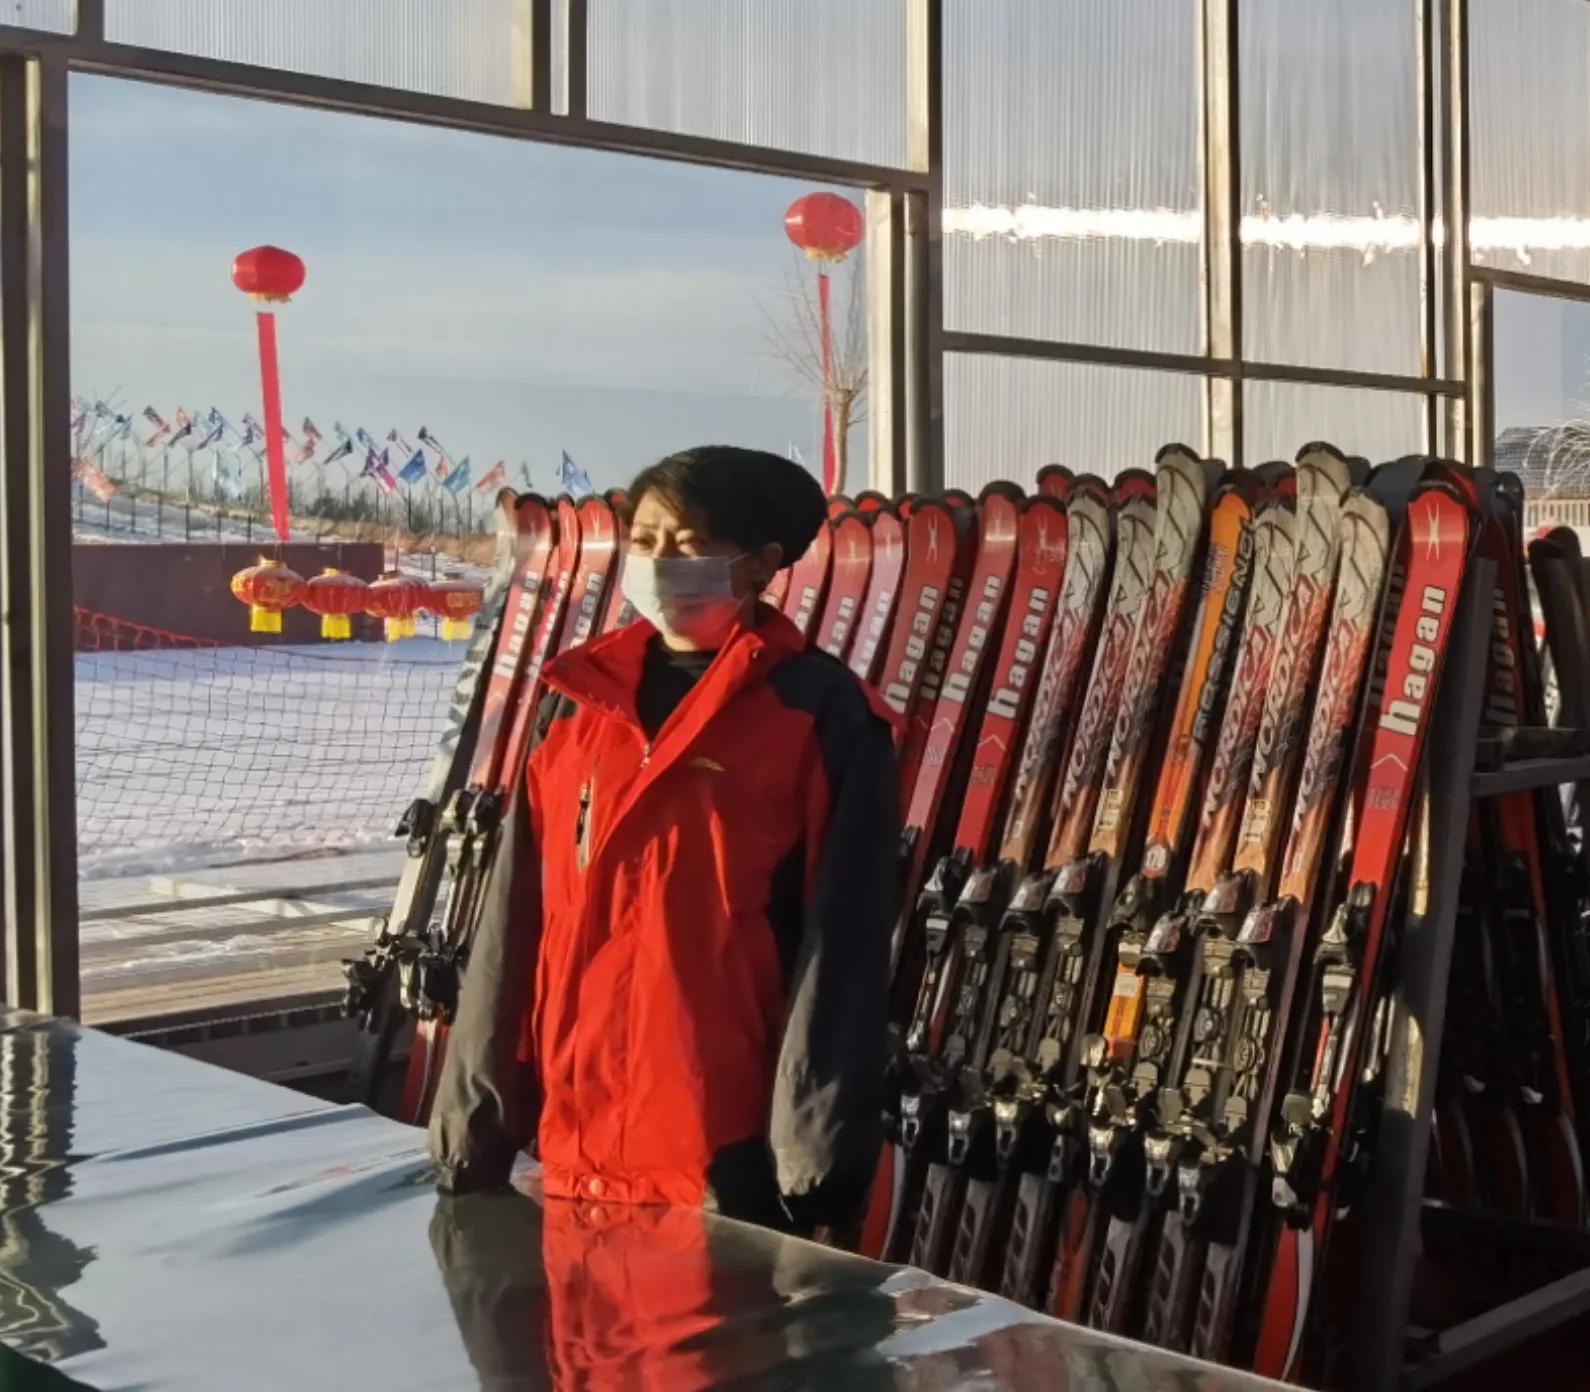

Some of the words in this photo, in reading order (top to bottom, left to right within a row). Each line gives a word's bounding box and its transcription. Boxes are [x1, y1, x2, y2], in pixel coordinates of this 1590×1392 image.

[880, 585, 939, 714] hagan
[940, 575, 1001, 704] hagan
[987, 587, 1049, 720] hagan
[1379, 584, 1446, 736] hagan
